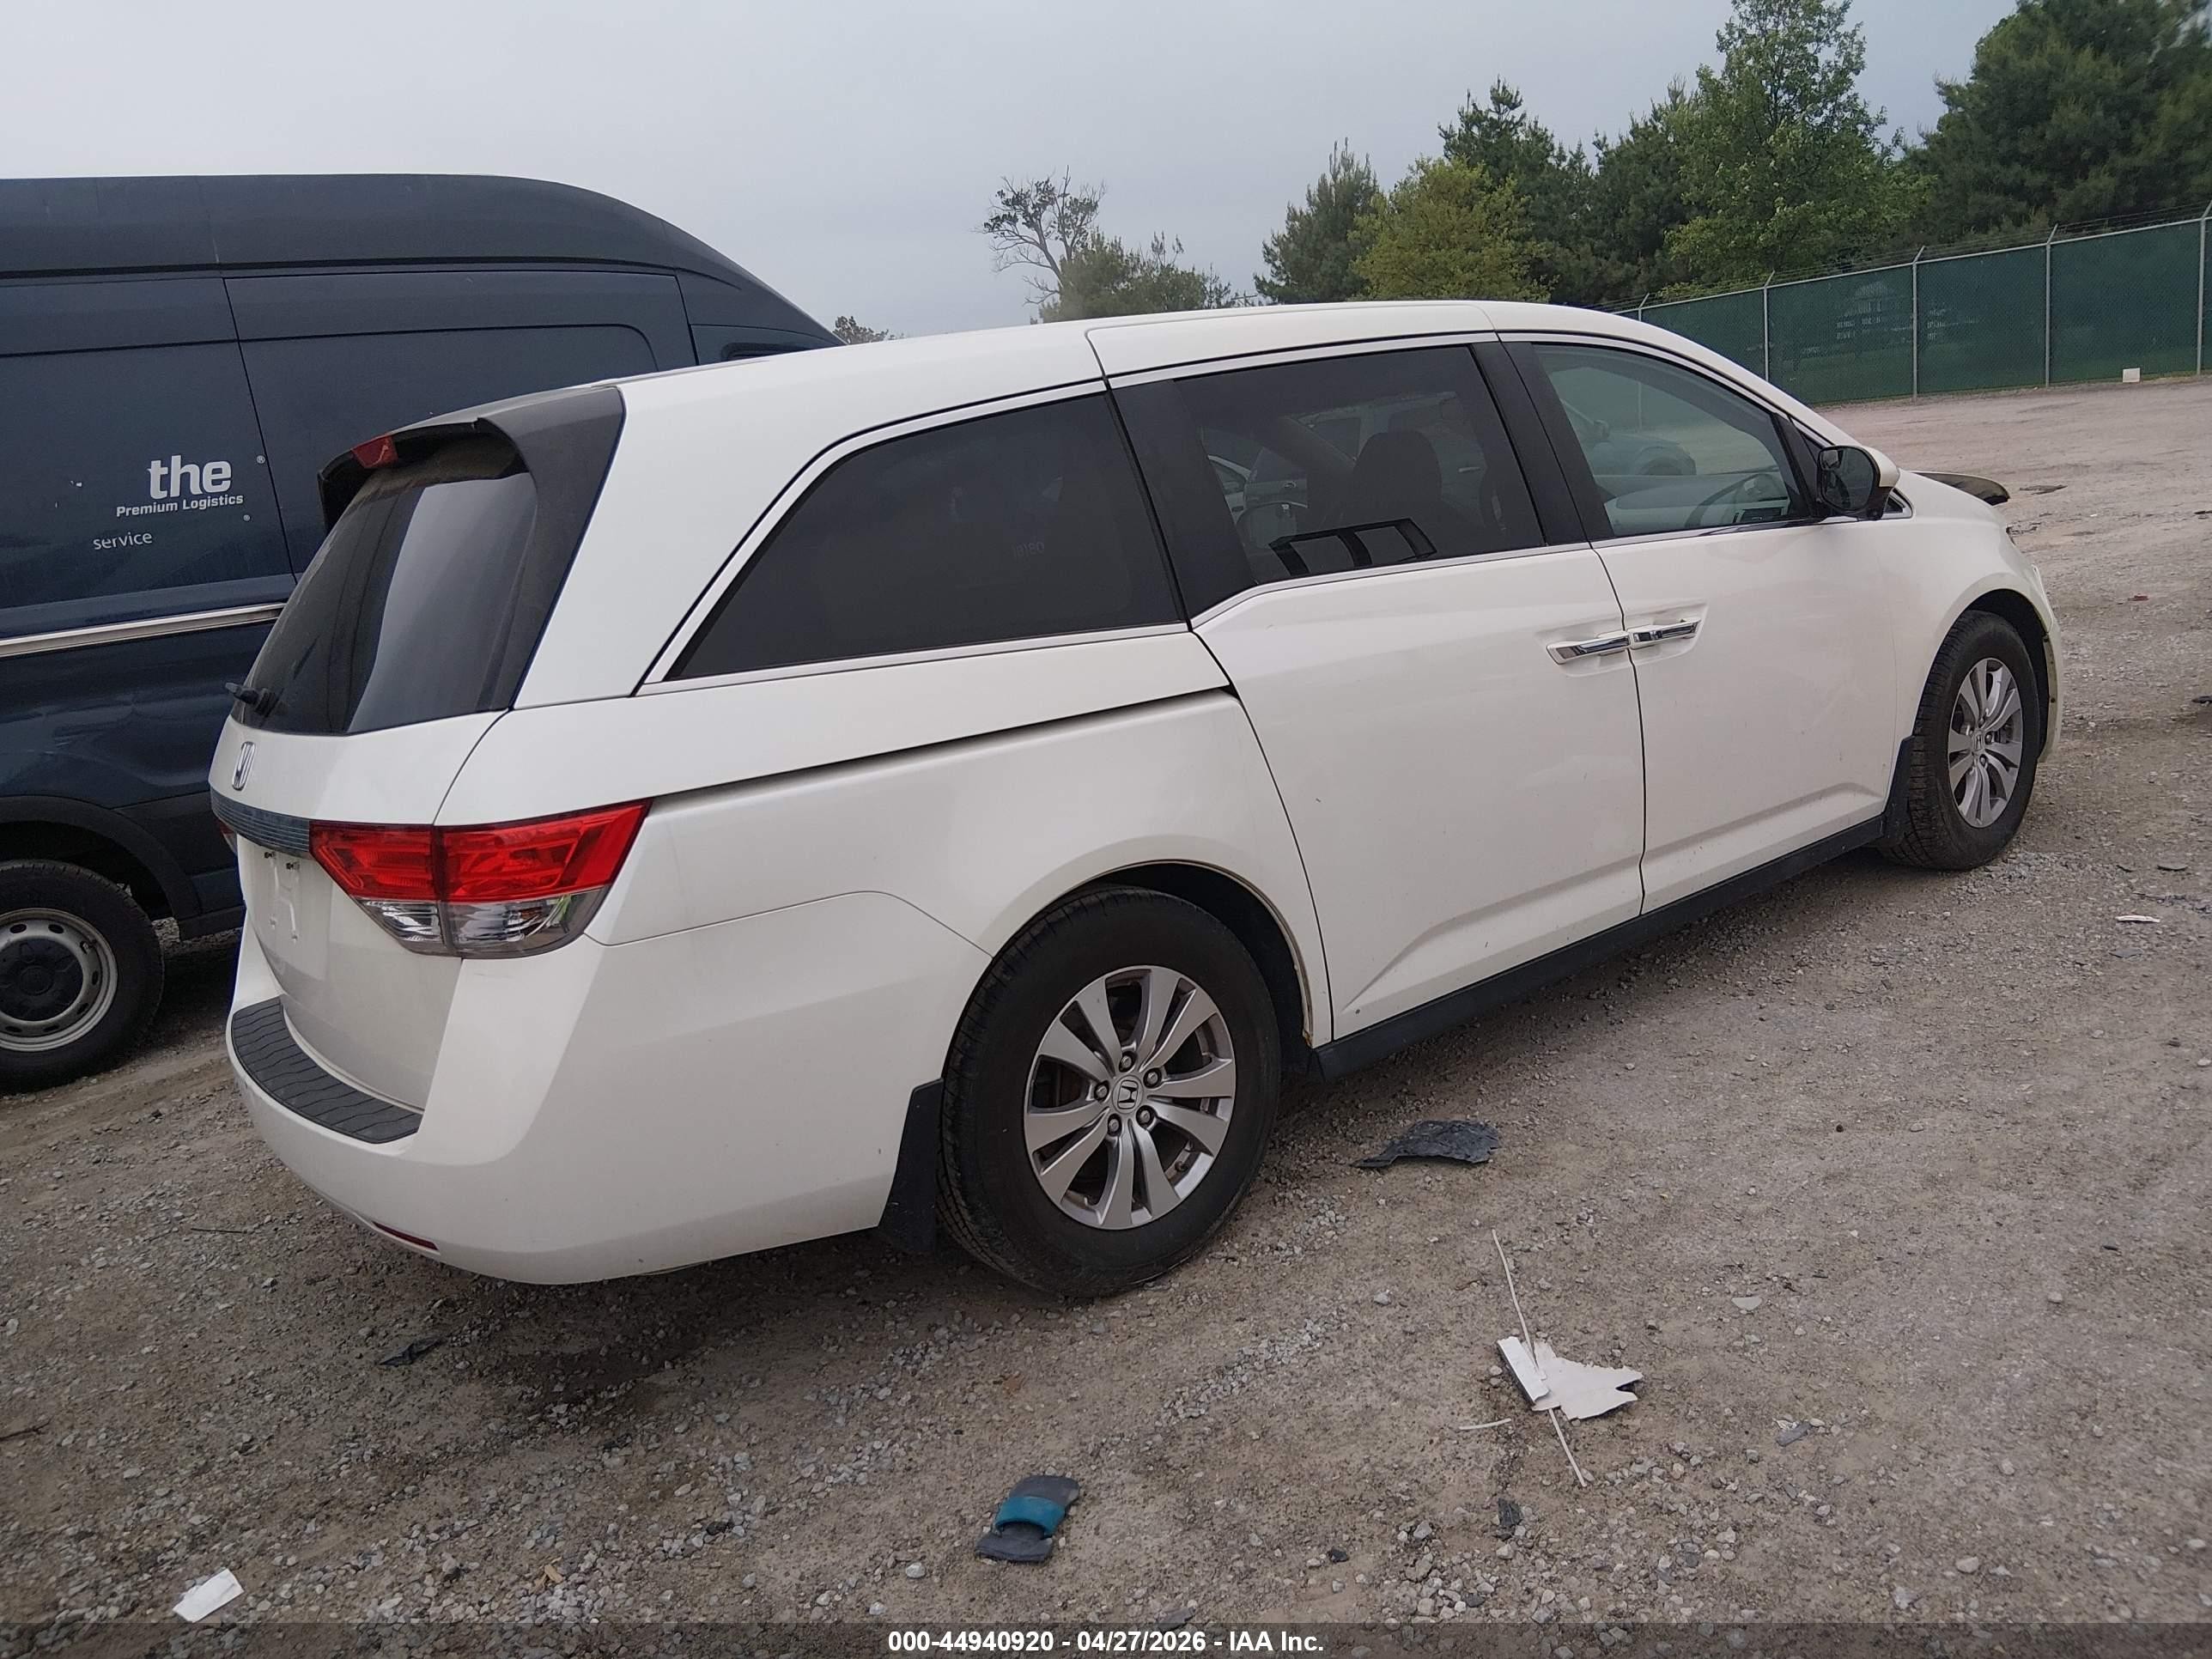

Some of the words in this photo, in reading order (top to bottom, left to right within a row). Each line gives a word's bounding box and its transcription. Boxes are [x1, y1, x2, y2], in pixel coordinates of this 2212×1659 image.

[147, 454, 232, 500] the
[116, 501, 178, 517] Premium
[182, 494, 244, 510] Logistics
[93, 532, 153, 550] service
